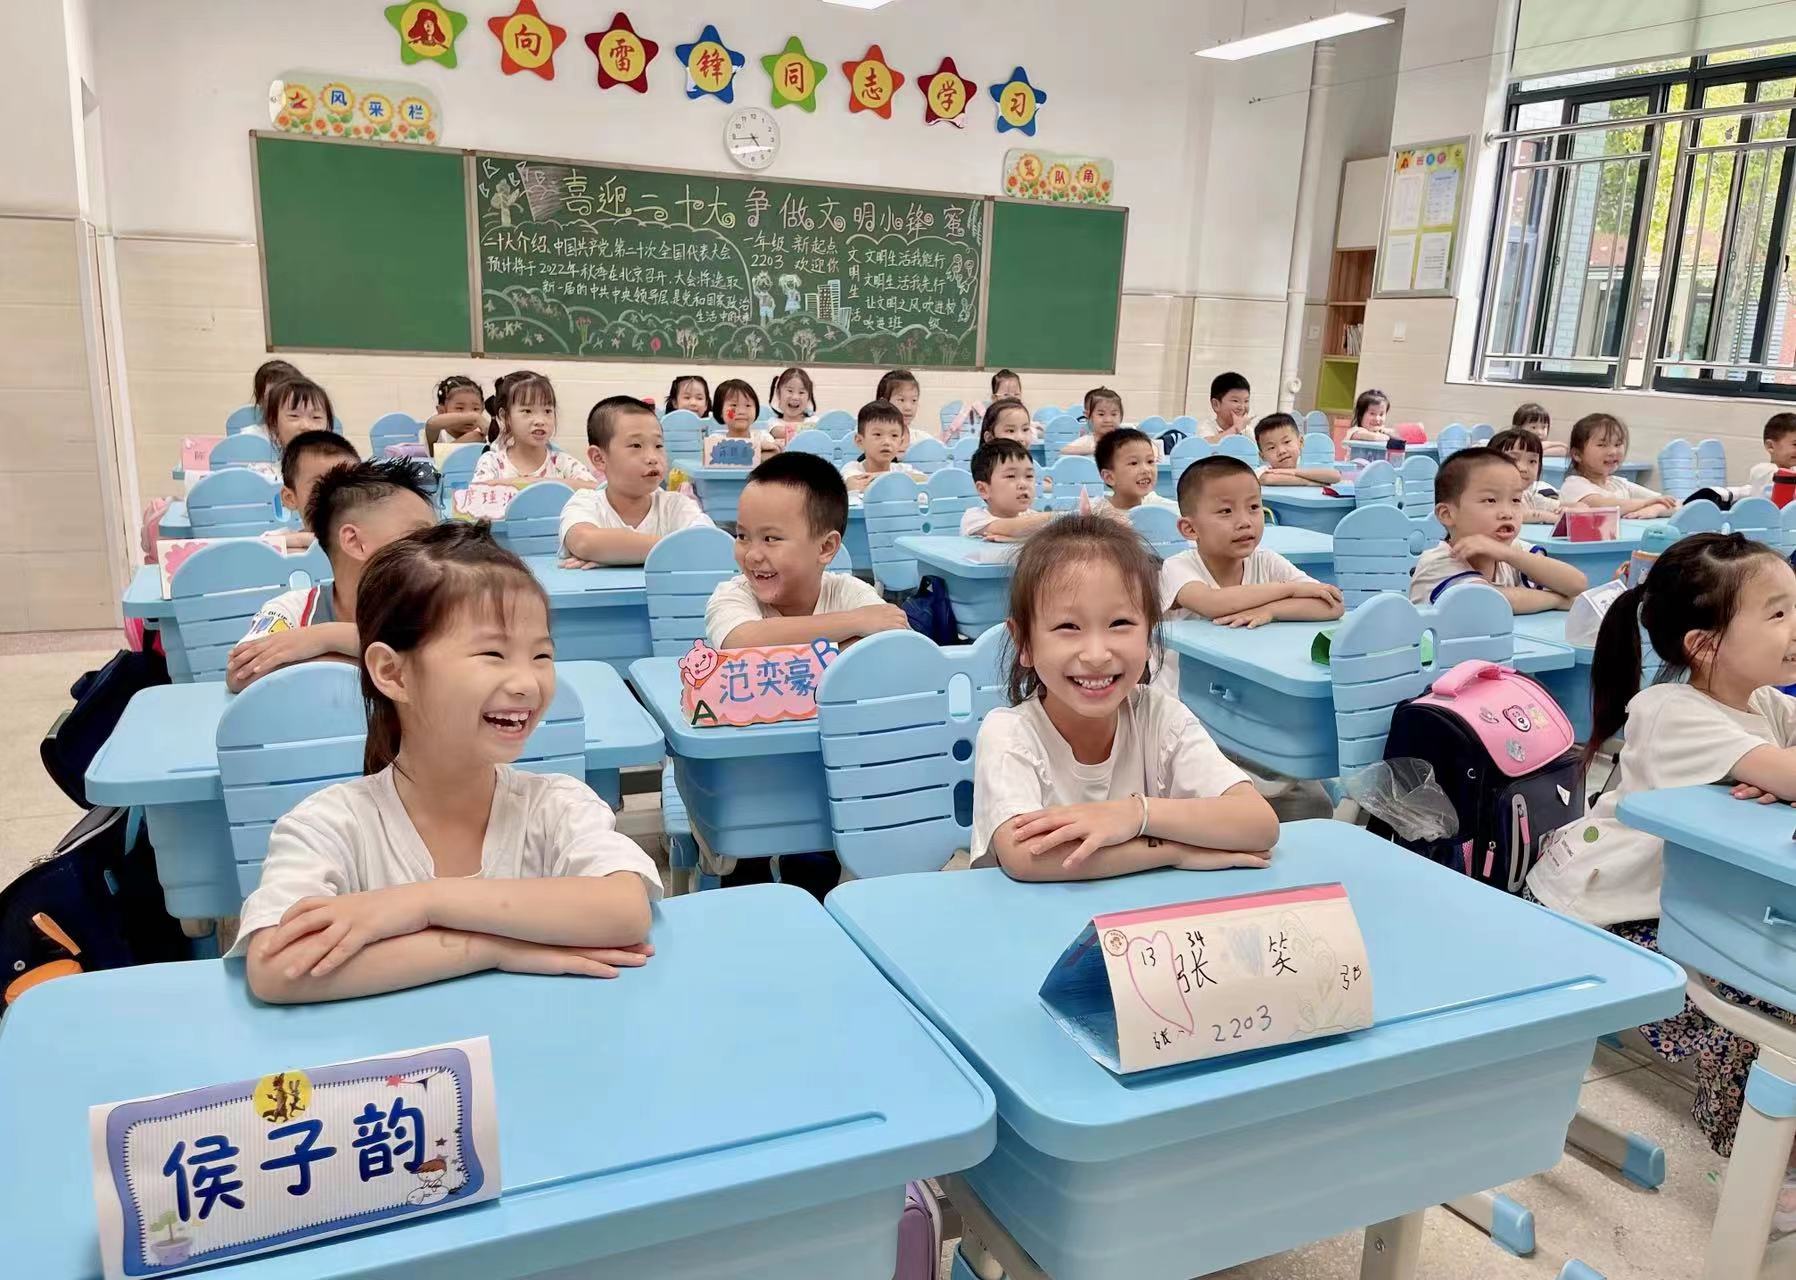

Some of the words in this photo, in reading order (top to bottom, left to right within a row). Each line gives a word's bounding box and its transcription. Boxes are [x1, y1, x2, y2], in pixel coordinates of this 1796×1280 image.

[560, 169, 736, 229] 喜迎二十大
[750, 254, 784, 269] 2203
[794, 256, 840, 274] 欢迎你
[865, 248, 946, 269] 文明生活我能行
[864, 272, 946, 294] 文明生活我先行
[719, 656, 816, 704] 范奕豪
[690, 700, 719, 726] A
[1186, 931, 1206, 947] 34
[1141, 947, 1156, 967] 13
[1211, 1004, 1272, 1042] 2203
[163, 1097, 426, 1222] 侯子韵
